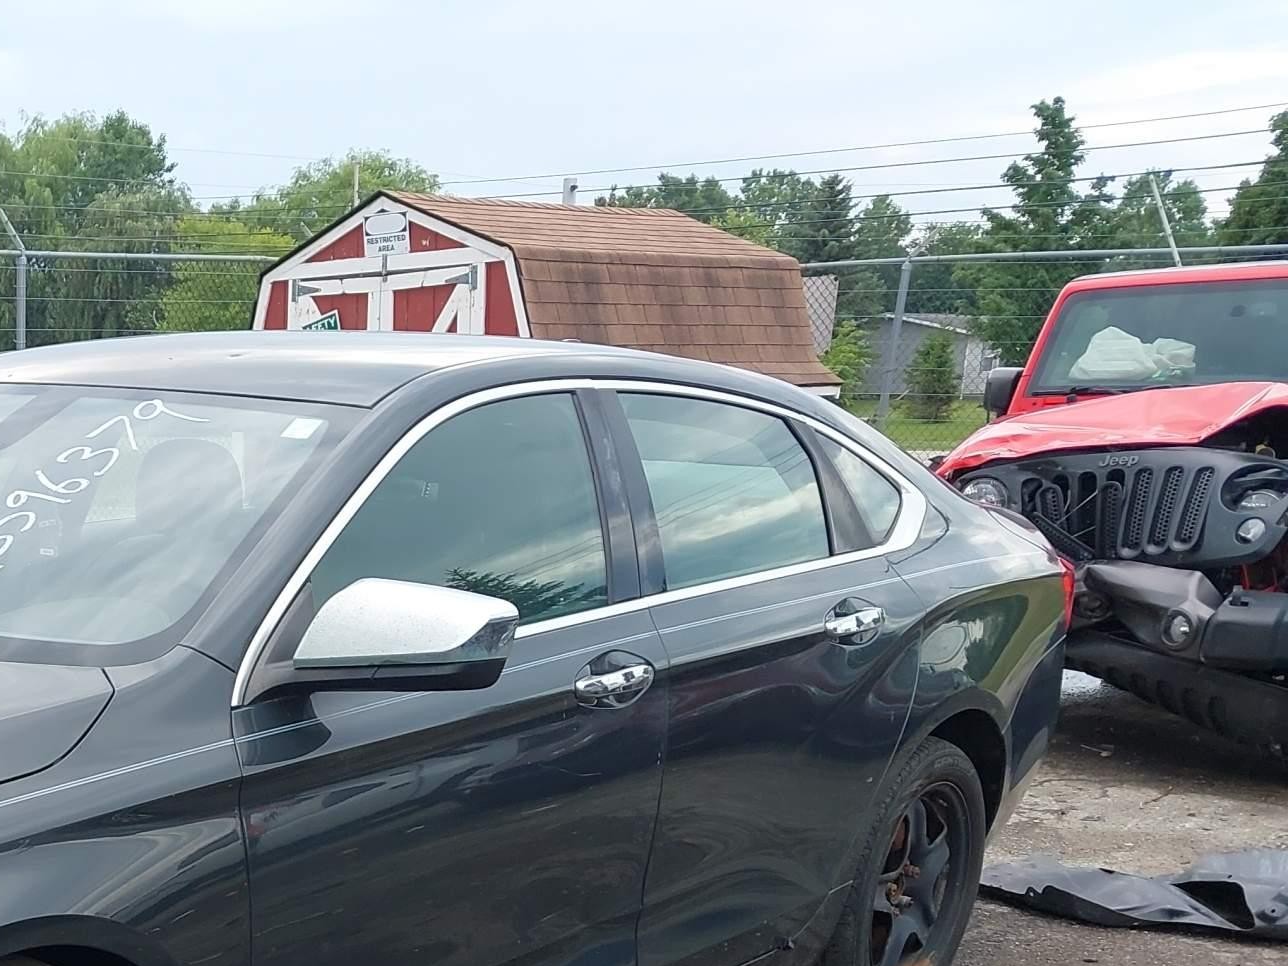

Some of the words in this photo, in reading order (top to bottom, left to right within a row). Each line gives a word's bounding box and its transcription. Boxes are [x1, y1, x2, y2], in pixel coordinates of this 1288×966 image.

[367, 234, 406, 245] RESTRICTED
[378, 244, 395, 252] AREA
[1098, 454, 1140, 467] Jeep
